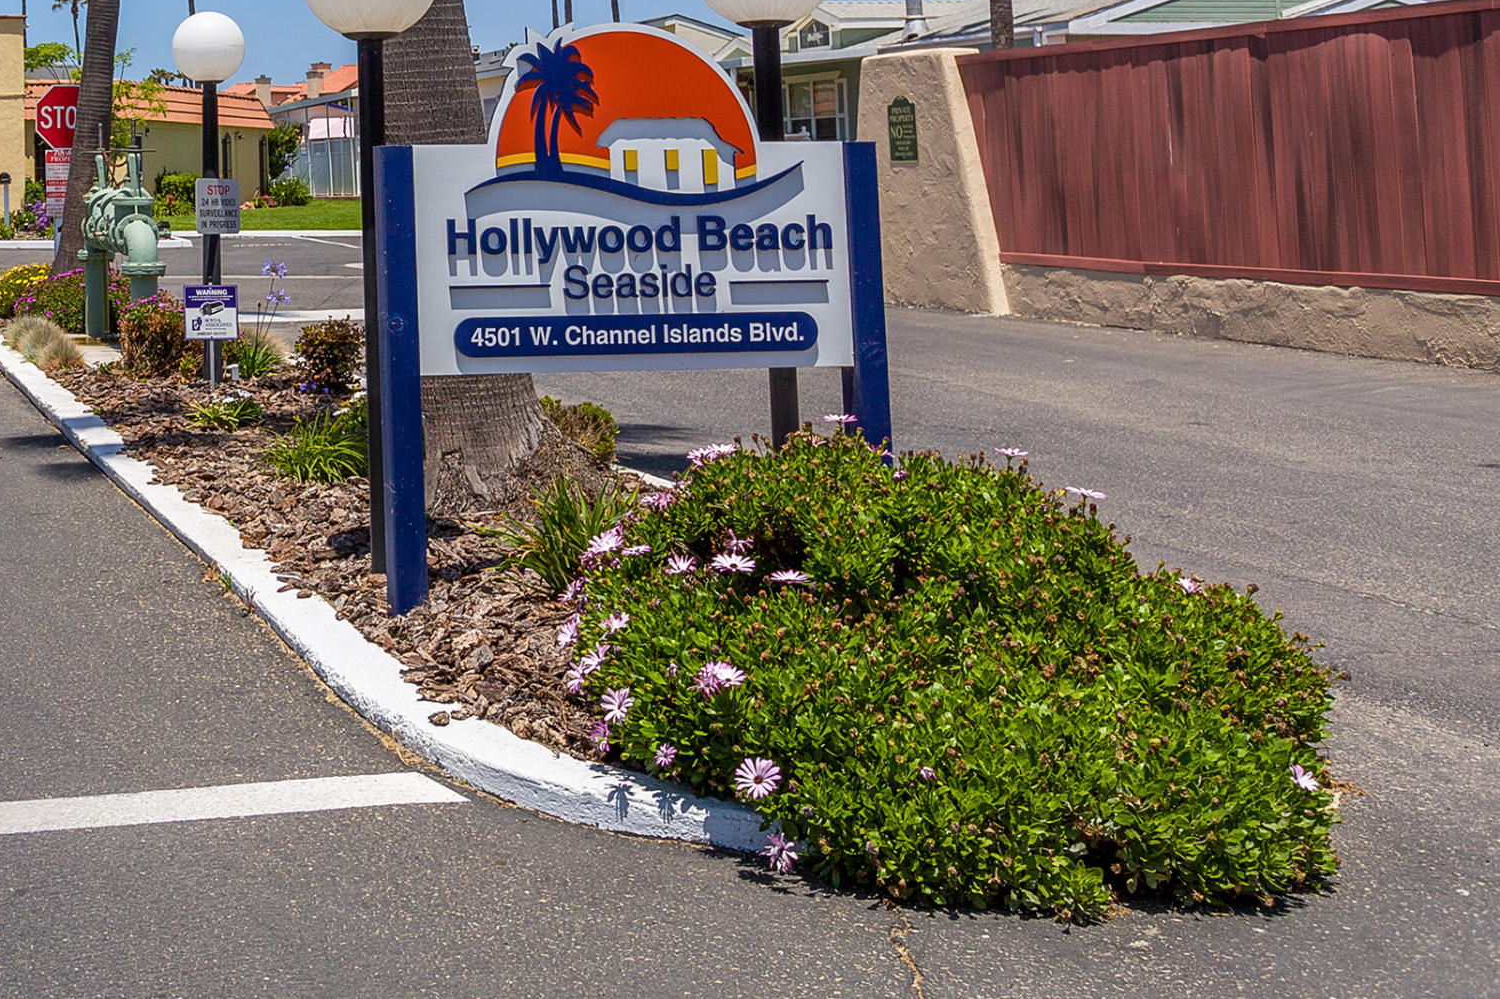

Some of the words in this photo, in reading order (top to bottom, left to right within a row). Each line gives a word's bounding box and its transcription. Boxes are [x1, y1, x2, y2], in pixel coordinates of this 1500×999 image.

[40, 106, 77, 129] STO
[890, 125, 903, 139] NO
[207, 184, 230, 195] STOP
[201, 198, 209, 206] 24
[211, 198, 219, 206] HR
[221, 198, 236, 206] VIDEO
[200, 209, 238, 218] SURVEILLANCE
[201, 220, 207, 228] IN
[210, 220, 236, 229] PROGRESS
[446, 215, 682, 265] Hollywood
[697, 213, 834, 252] Beach
[563, 263, 717, 301] Seaside
[470, 326, 521, 347] 4501
[529, 325, 558, 346] W.
[565, 324, 657, 346] Channel
[663, 323, 743, 344] Islands
[749, 321, 805, 342] Blvd.
